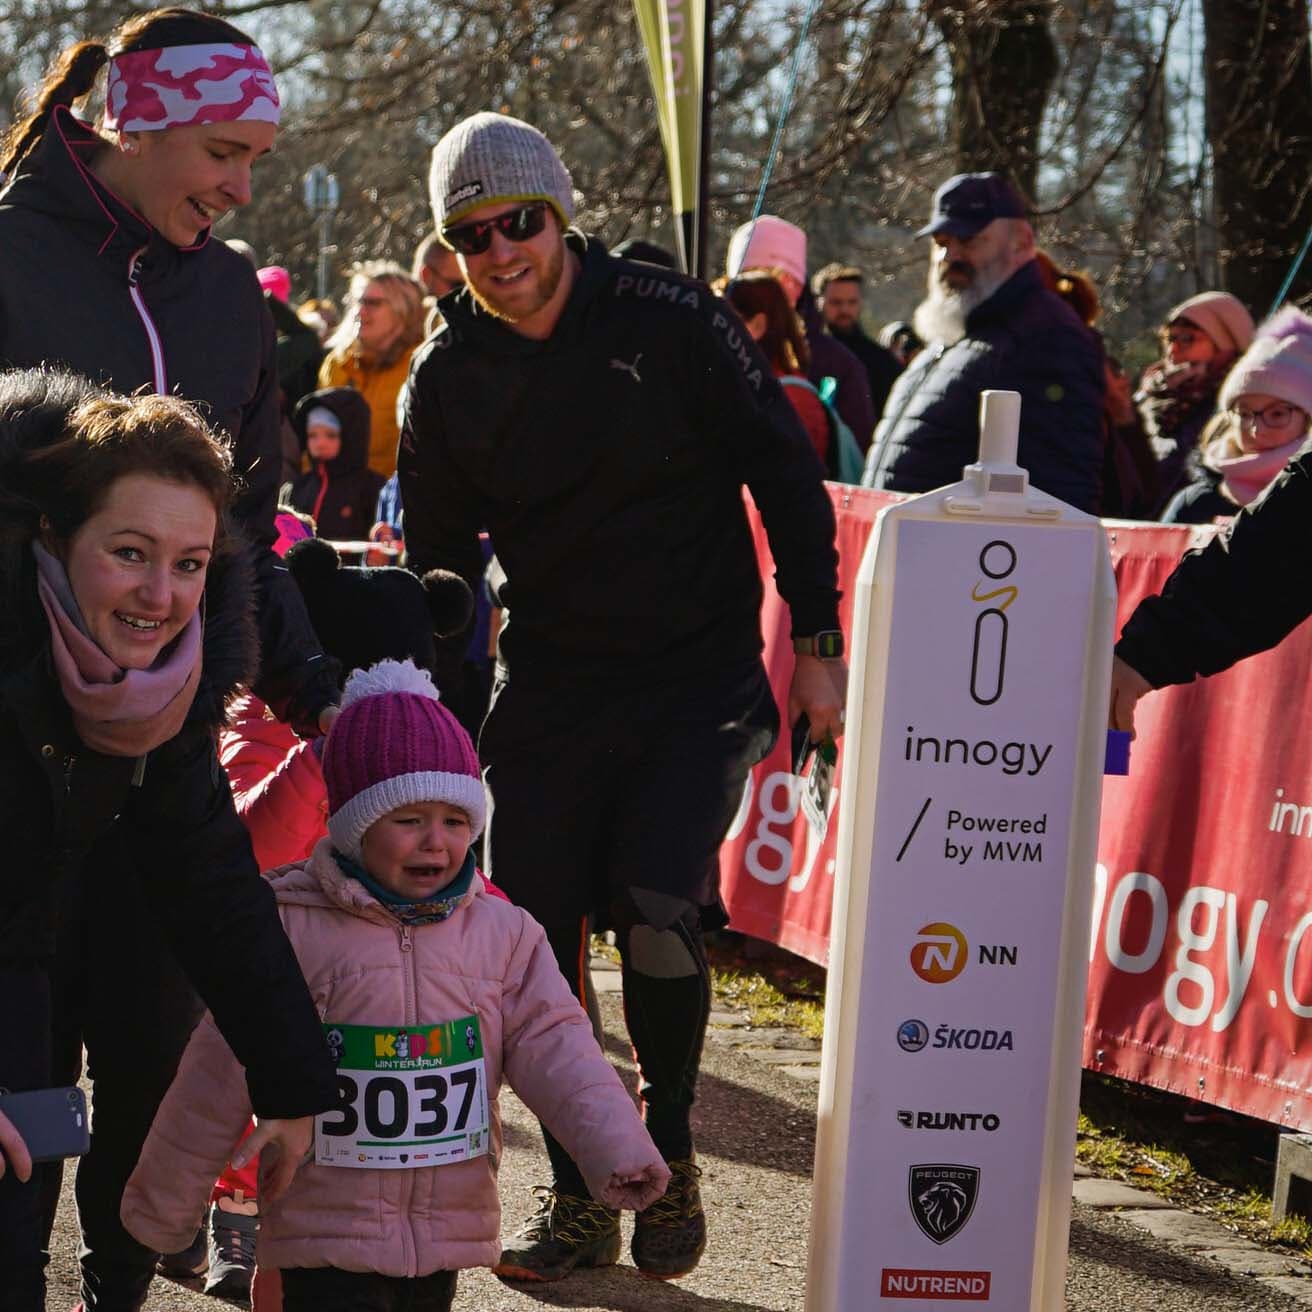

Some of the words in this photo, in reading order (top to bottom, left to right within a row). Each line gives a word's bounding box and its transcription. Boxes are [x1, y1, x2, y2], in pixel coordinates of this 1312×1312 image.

[615, 274, 700, 309] PUMA
[712, 311, 763, 392] PUMA
[903, 725, 1054, 776] innogy
[946, 810, 1048, 835] Powered
[944, 839, 974, 865] by
[983, 841, 1043, 863] MVM
[977, 945, 1019, 966] NN
[931, 1022, 1015, 1052] ŠKODA
[321, 1067, 477, 1139] 3037
[916, 1110, 1001, 1132] RUNTO
[915, 1170, 974, 1181] PEUGEOT
[887, 1274, 986, 1296] NUTREND
